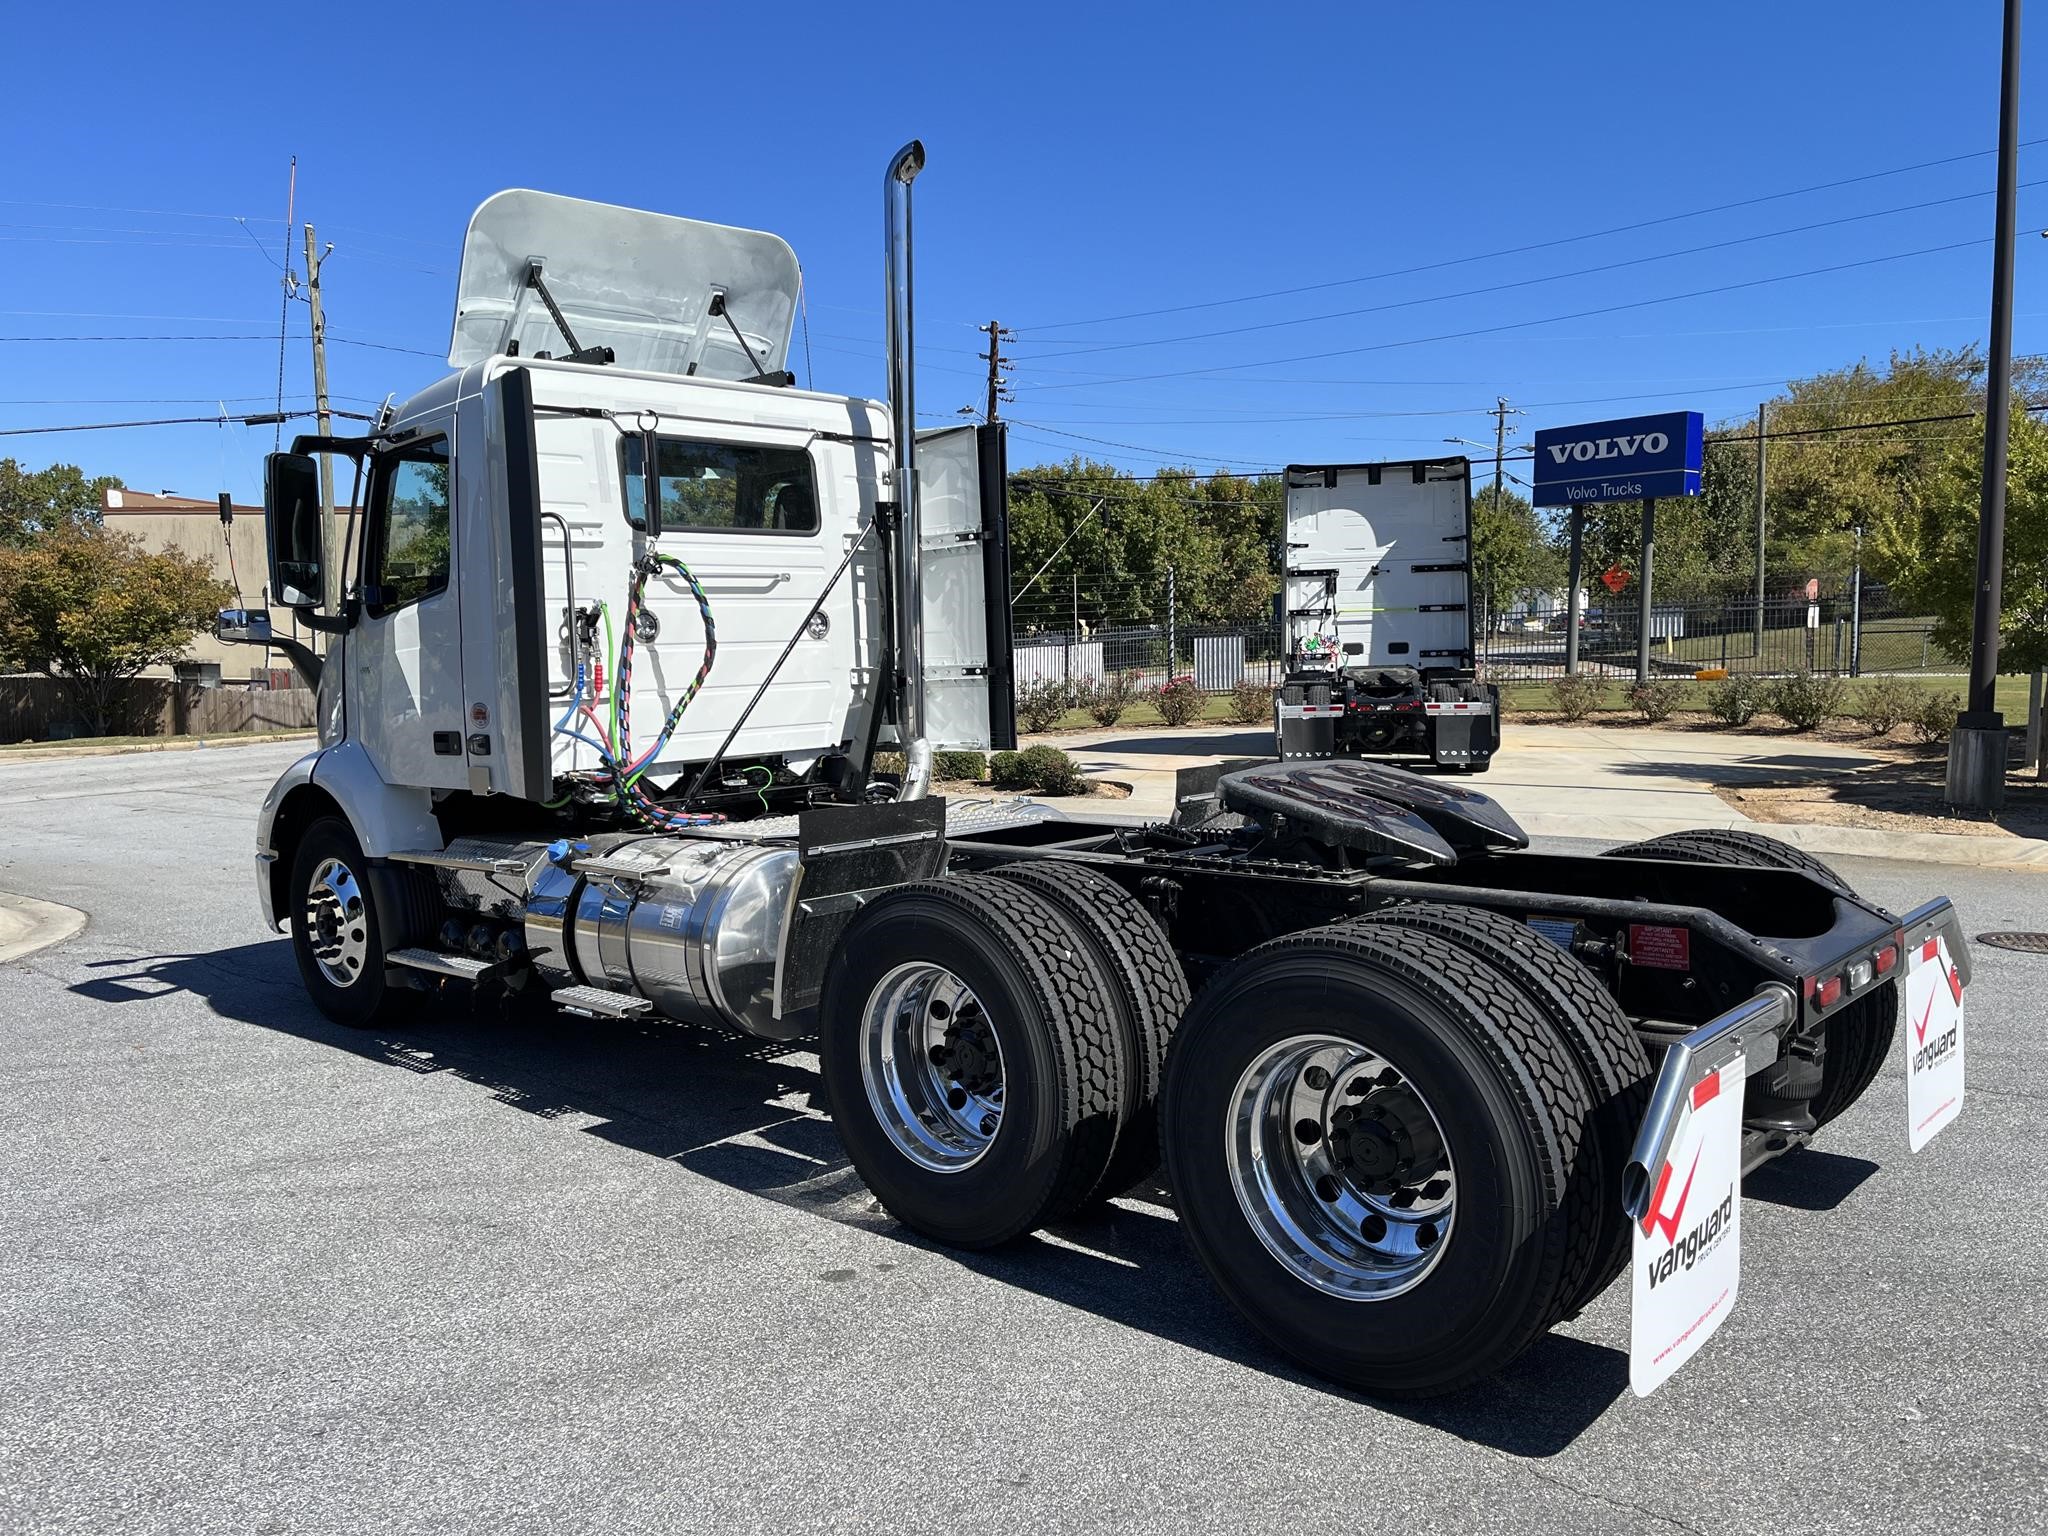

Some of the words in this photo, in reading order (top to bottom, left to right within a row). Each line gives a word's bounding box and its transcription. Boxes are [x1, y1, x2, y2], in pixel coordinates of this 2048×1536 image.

[1547, 432, 1669, 464] VOLVO
[1566, 486, 1598, 500] Volvo
[1601, 481, 1642, 497] Trucks
[1913, 1019, 1957, 1076] vanguard
[1648, 1182, 1733, 1290] vanguard
